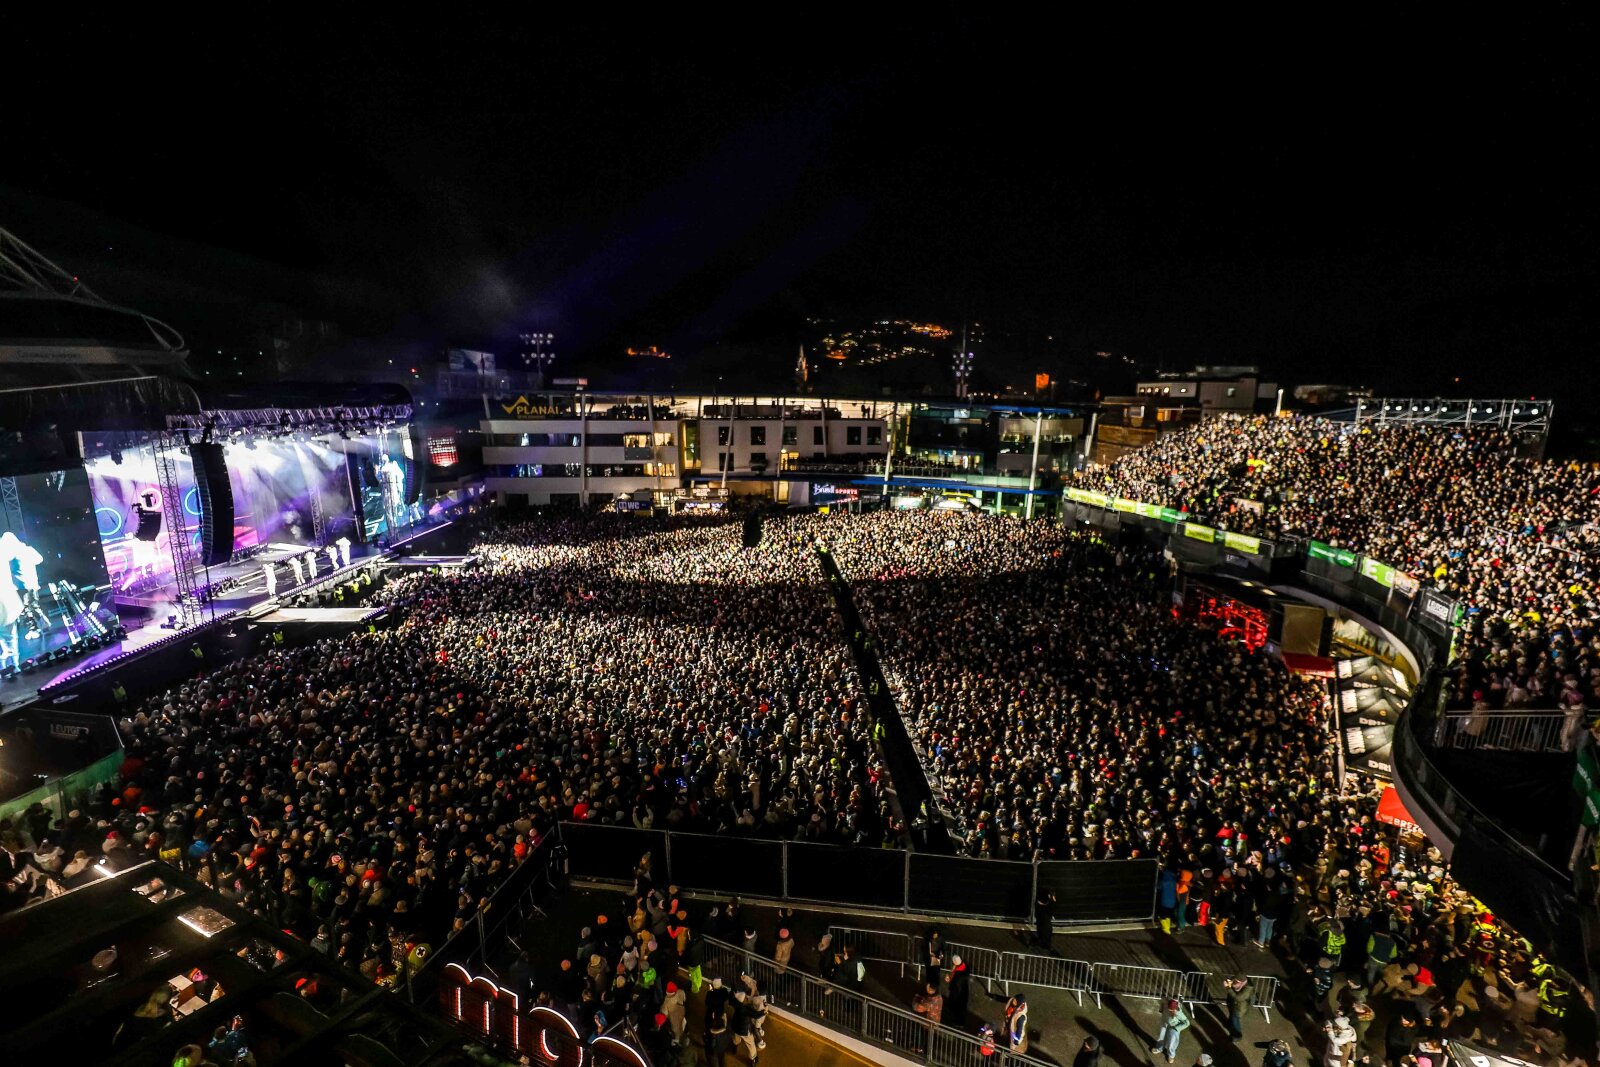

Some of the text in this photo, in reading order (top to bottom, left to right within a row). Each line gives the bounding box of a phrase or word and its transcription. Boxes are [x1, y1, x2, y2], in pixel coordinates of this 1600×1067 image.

[516, 406, 559, 415] PLANAI
[627, 501, 640, 510] WC
[1368, 760, 1392, 773] DRI
